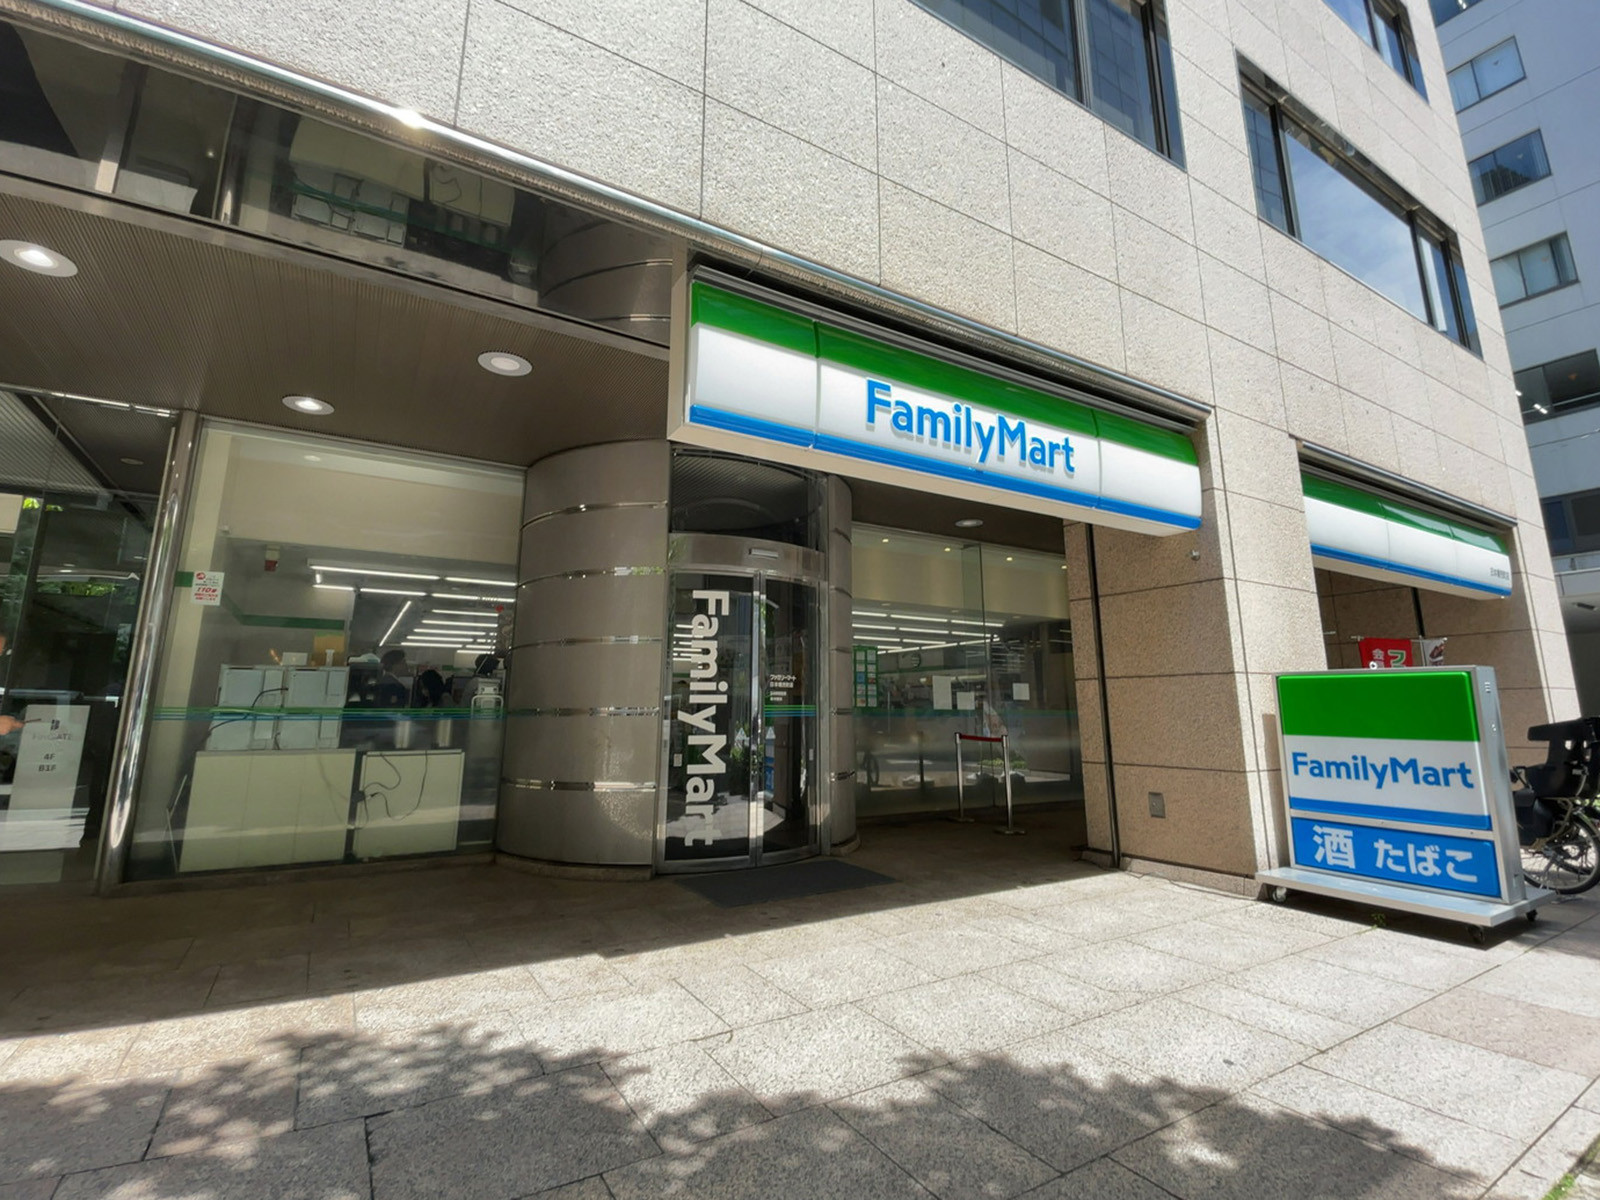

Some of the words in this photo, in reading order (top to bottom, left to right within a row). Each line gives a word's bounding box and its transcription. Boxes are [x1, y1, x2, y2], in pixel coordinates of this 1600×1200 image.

[866, 378, 1075, 472] FamilyMart
[677, 589, 730, 846] FamilyMart
[1292, 752, 1475, 789] FamilyMart
[1312, 825, 1356, 870] 酒
[1373, 839, 1478, 883] たばこ
